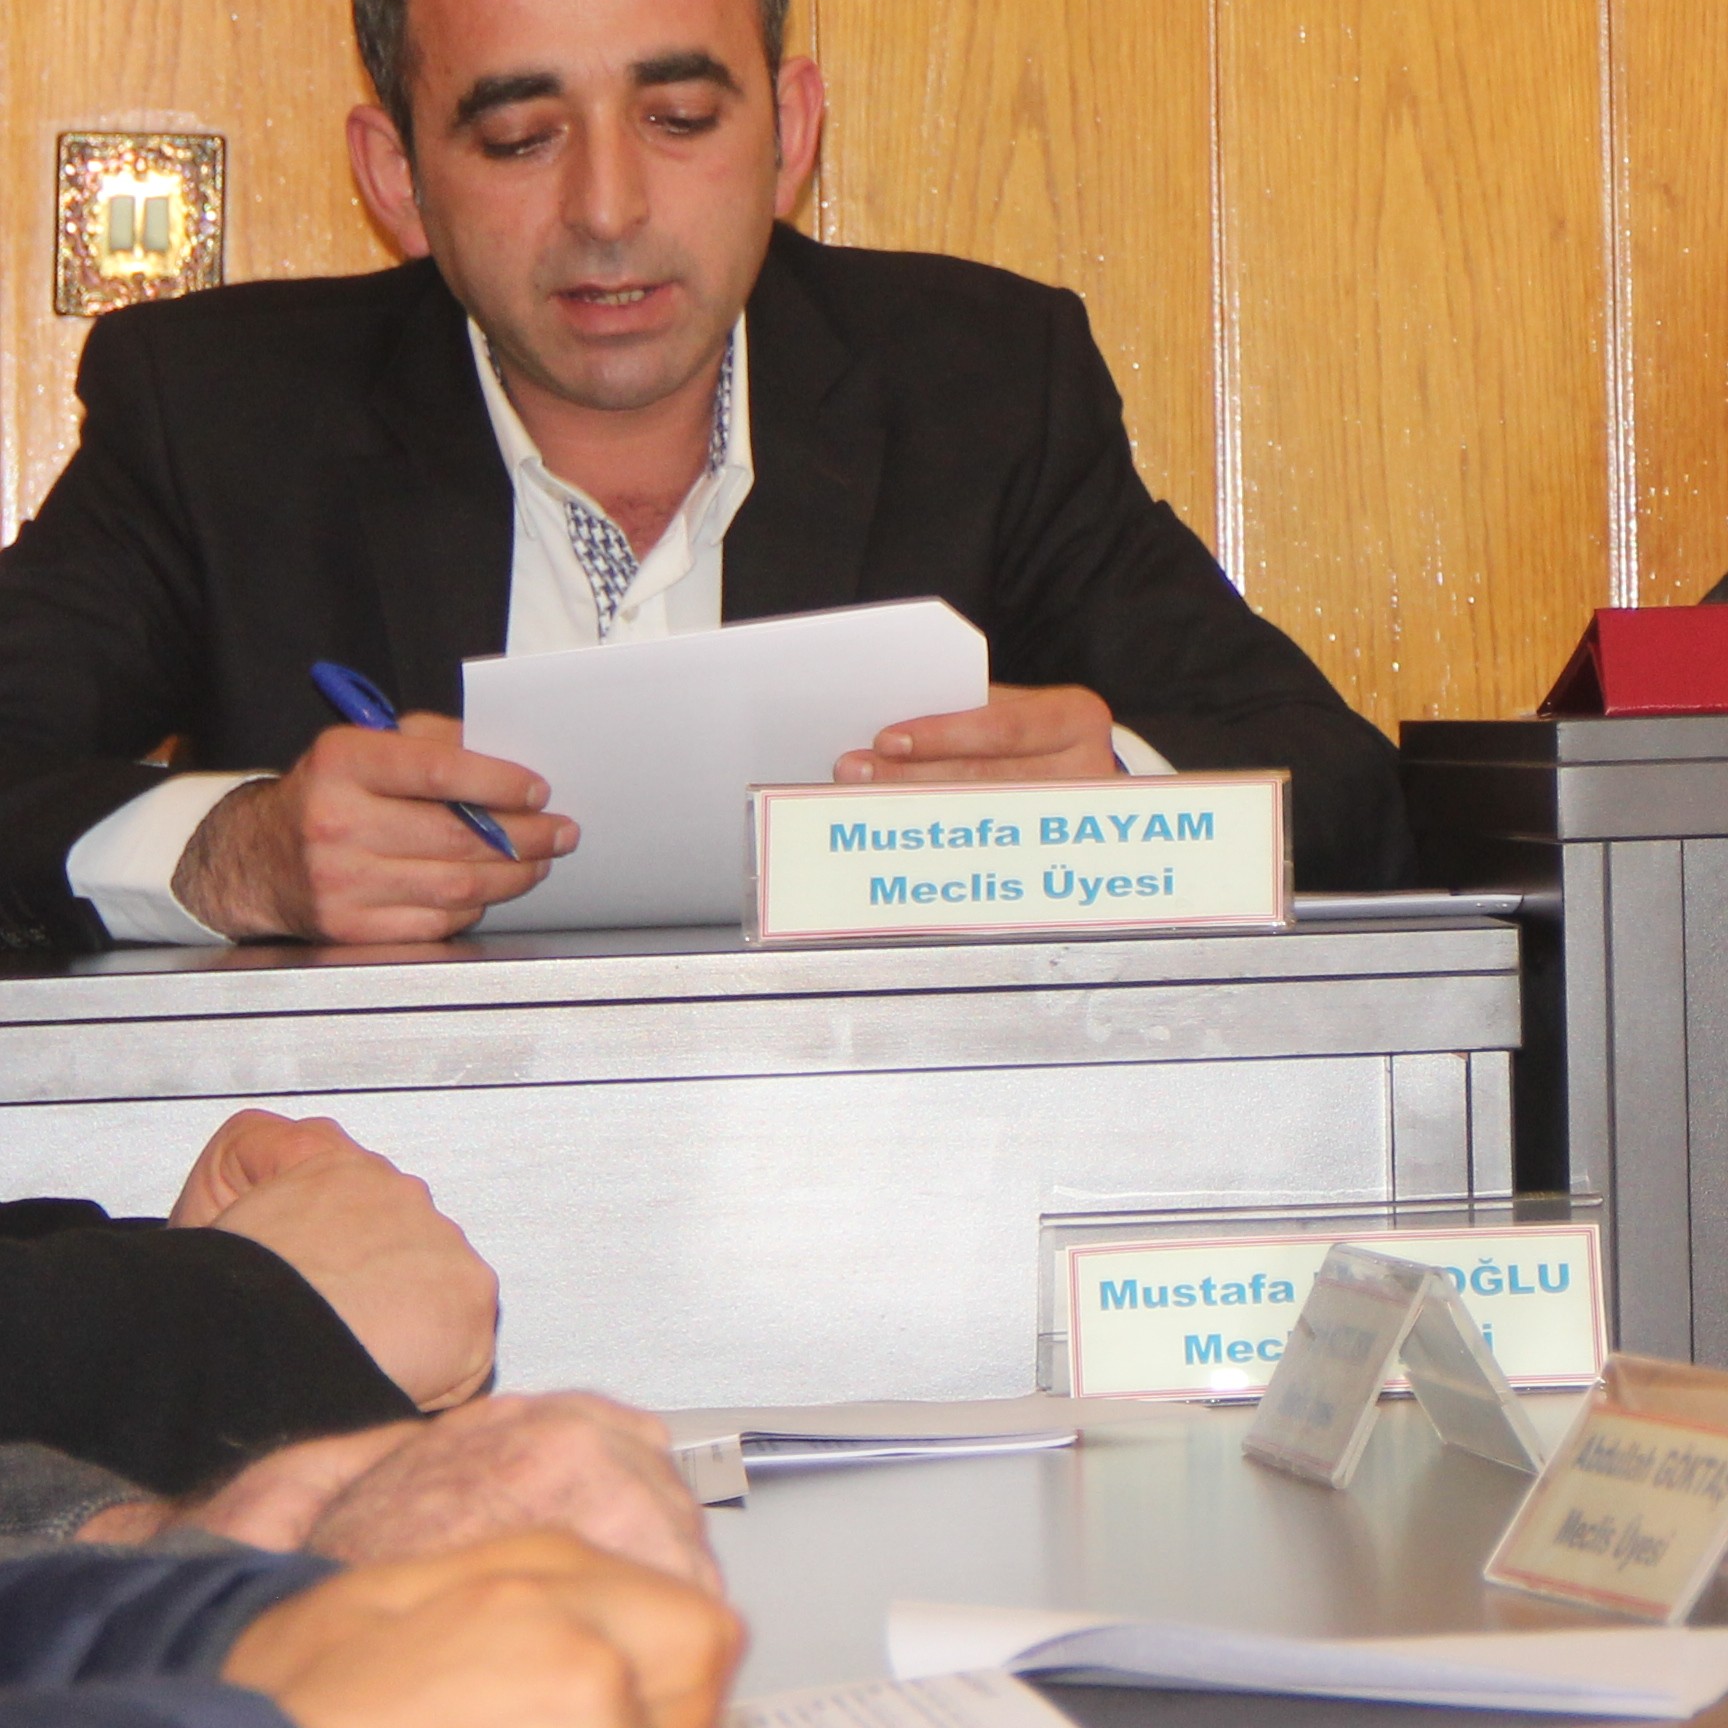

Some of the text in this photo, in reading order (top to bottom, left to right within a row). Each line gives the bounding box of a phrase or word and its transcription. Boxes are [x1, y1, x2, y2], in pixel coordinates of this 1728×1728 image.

[829, 811, 1215, 853] Mustafa BAYAM
[868, 865, 1176, 906] Meclis Üyesi
[1099, 1272, 1296, 1312] Mustafa
